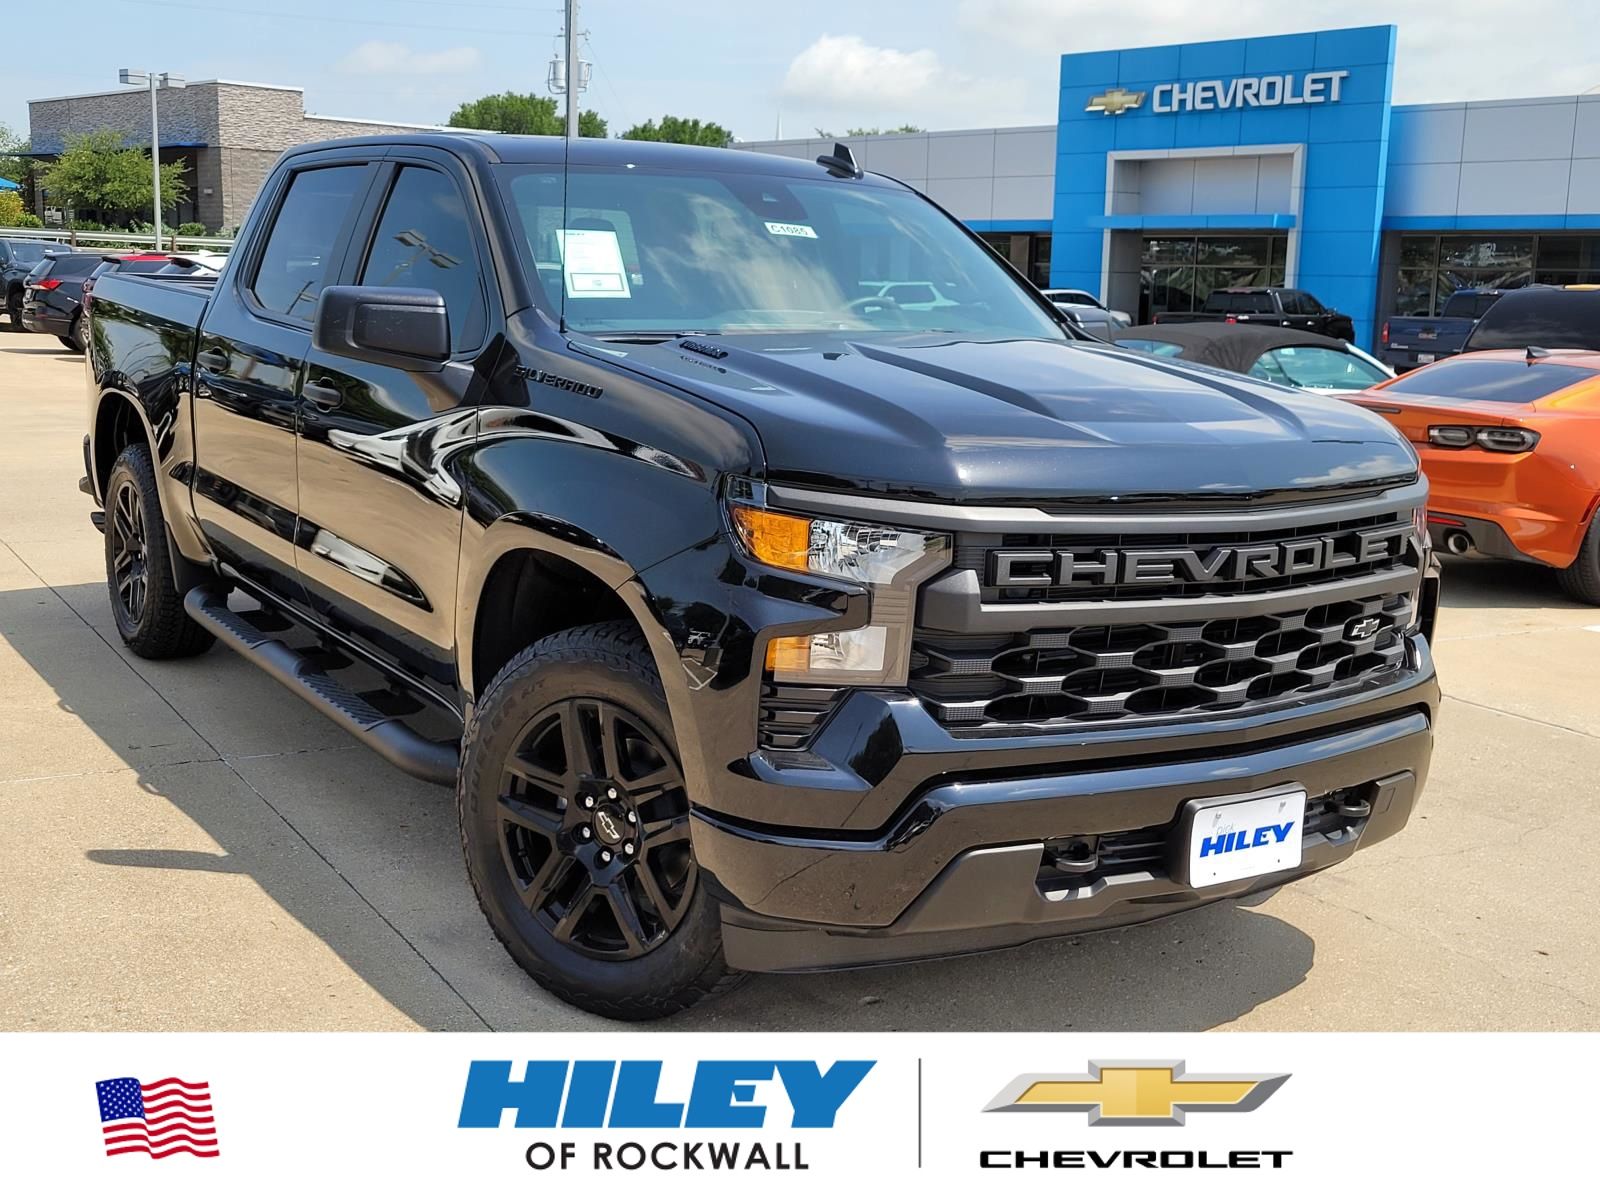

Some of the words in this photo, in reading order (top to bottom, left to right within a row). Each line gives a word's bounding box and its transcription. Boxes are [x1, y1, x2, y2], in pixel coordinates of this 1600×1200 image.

[1152, 70, 1349, 113] CHEVROLET
[513, 364, 603, 399] SILVERADO
[992, 526, 1417, 586] CHEVROLET
[1200, 821, 1295, 858] HILEY
